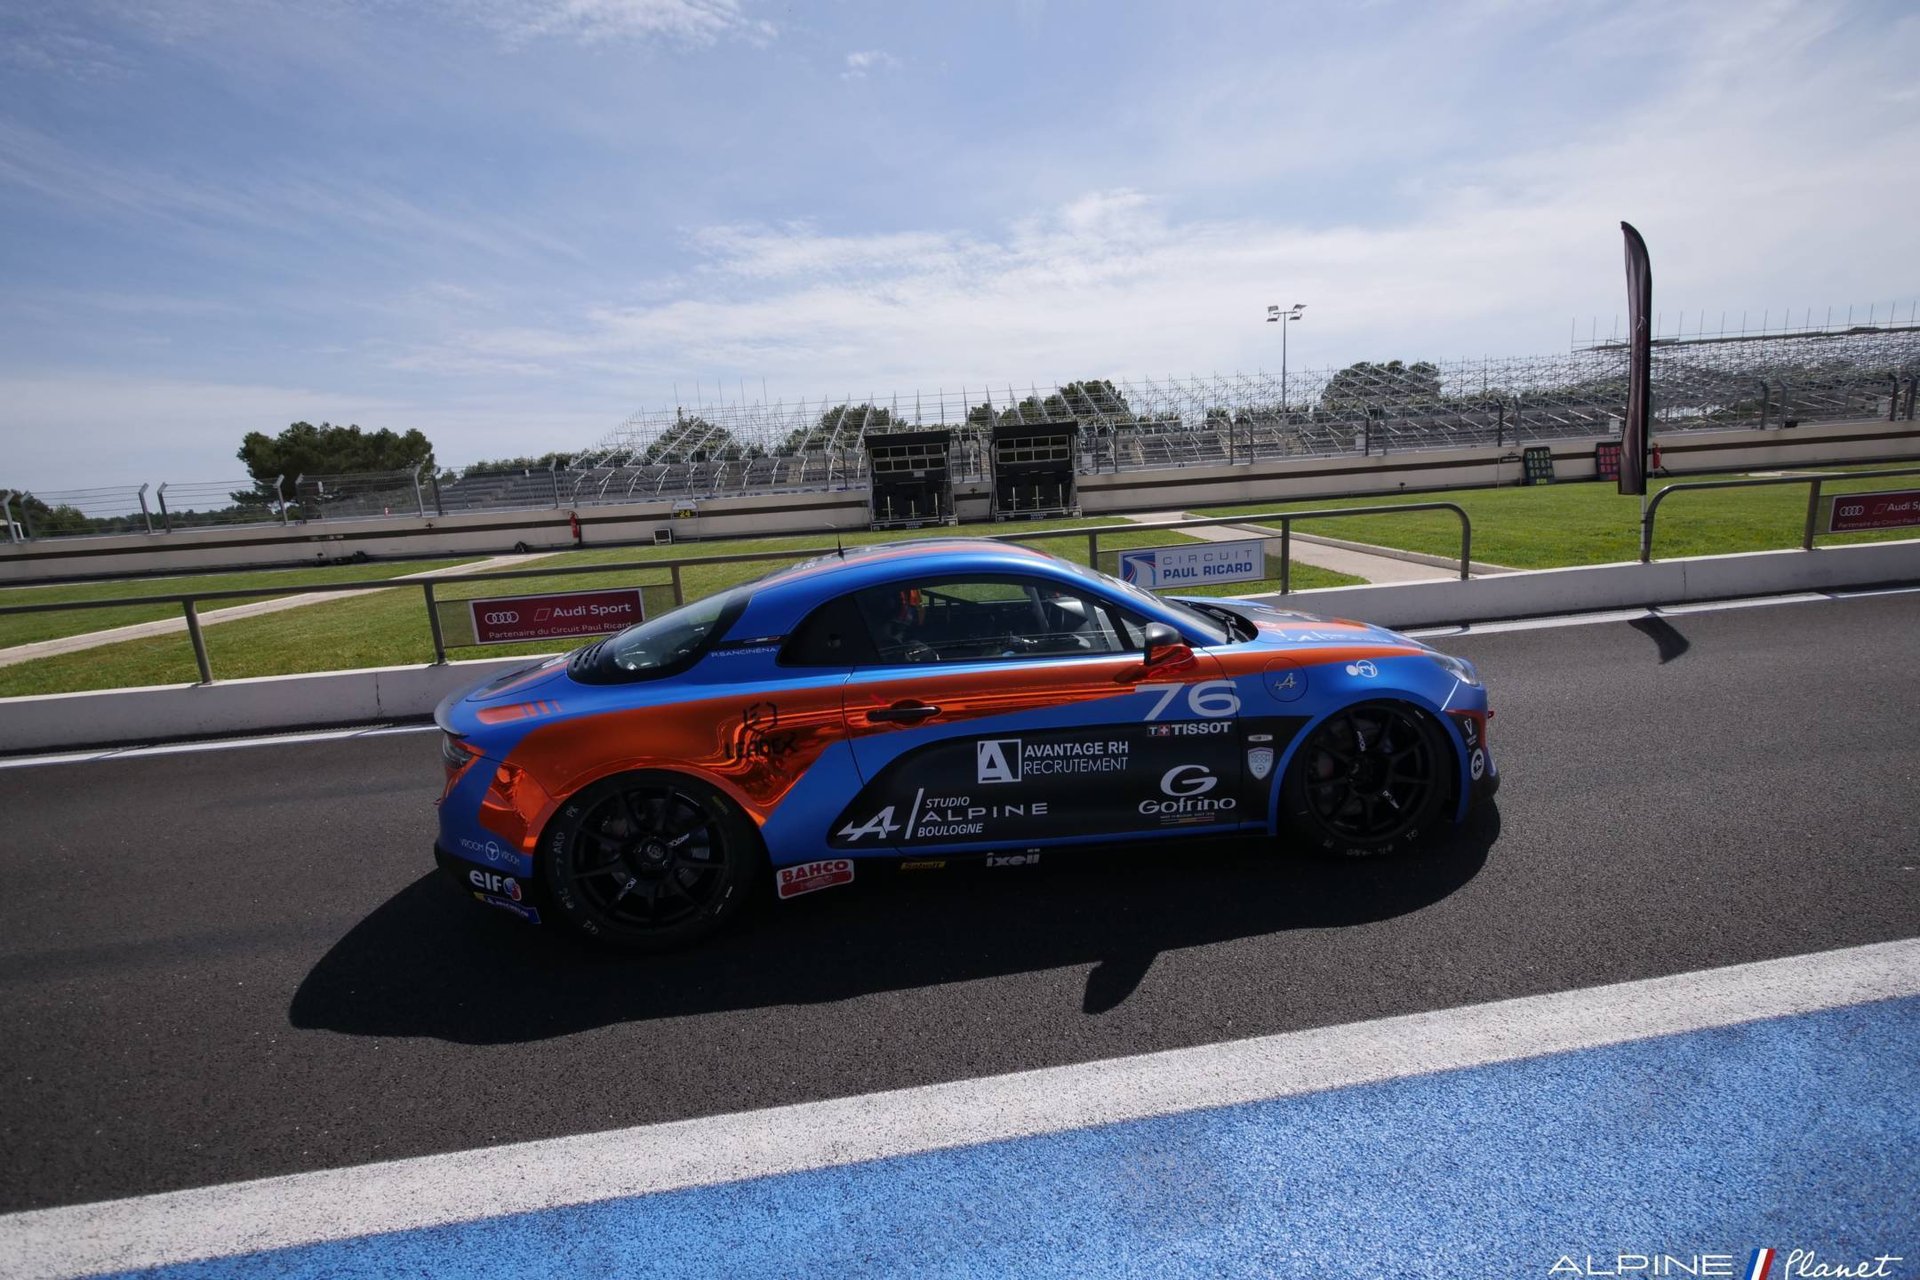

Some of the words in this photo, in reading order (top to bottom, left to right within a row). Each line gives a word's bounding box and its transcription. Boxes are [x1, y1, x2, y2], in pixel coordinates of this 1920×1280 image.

[1886, 502, 1911, 512] Audi
[1163, 550, 1253, 566] CIRCUIT
[1163, 568, 1198, 580] PAUL
[1203, 562, 1253, 576] RICARD
[553, 604, 587, 618] Audi
[590, 603, 632, 618] Sport
[489, 629, 535, 640] Partenaire
[537, 626, 550, 636] du
[551, 625, 581, 635] Circuit
[582, 623, 601, 632] Paul
[604, 620, 632, 630] Ricard
[1135, 679, 1242, 721] 76
[1172, 722, 1232, 736] TISSOT
[1024, 742, 1104, 758] AVANTAGE
[1108, 741, 1129, 755] RH
[1024, 757, 1129, 775] RECRUTEMENT
[925, 796, 970, 809] STUDIO
[1138, 796, 1237, 815] Gofrino
[921, 802, 1049, 823] ALPINE
[917, 822, 984, 838] BOULOGNE
[781, 860, 849, 884] BAHCO
